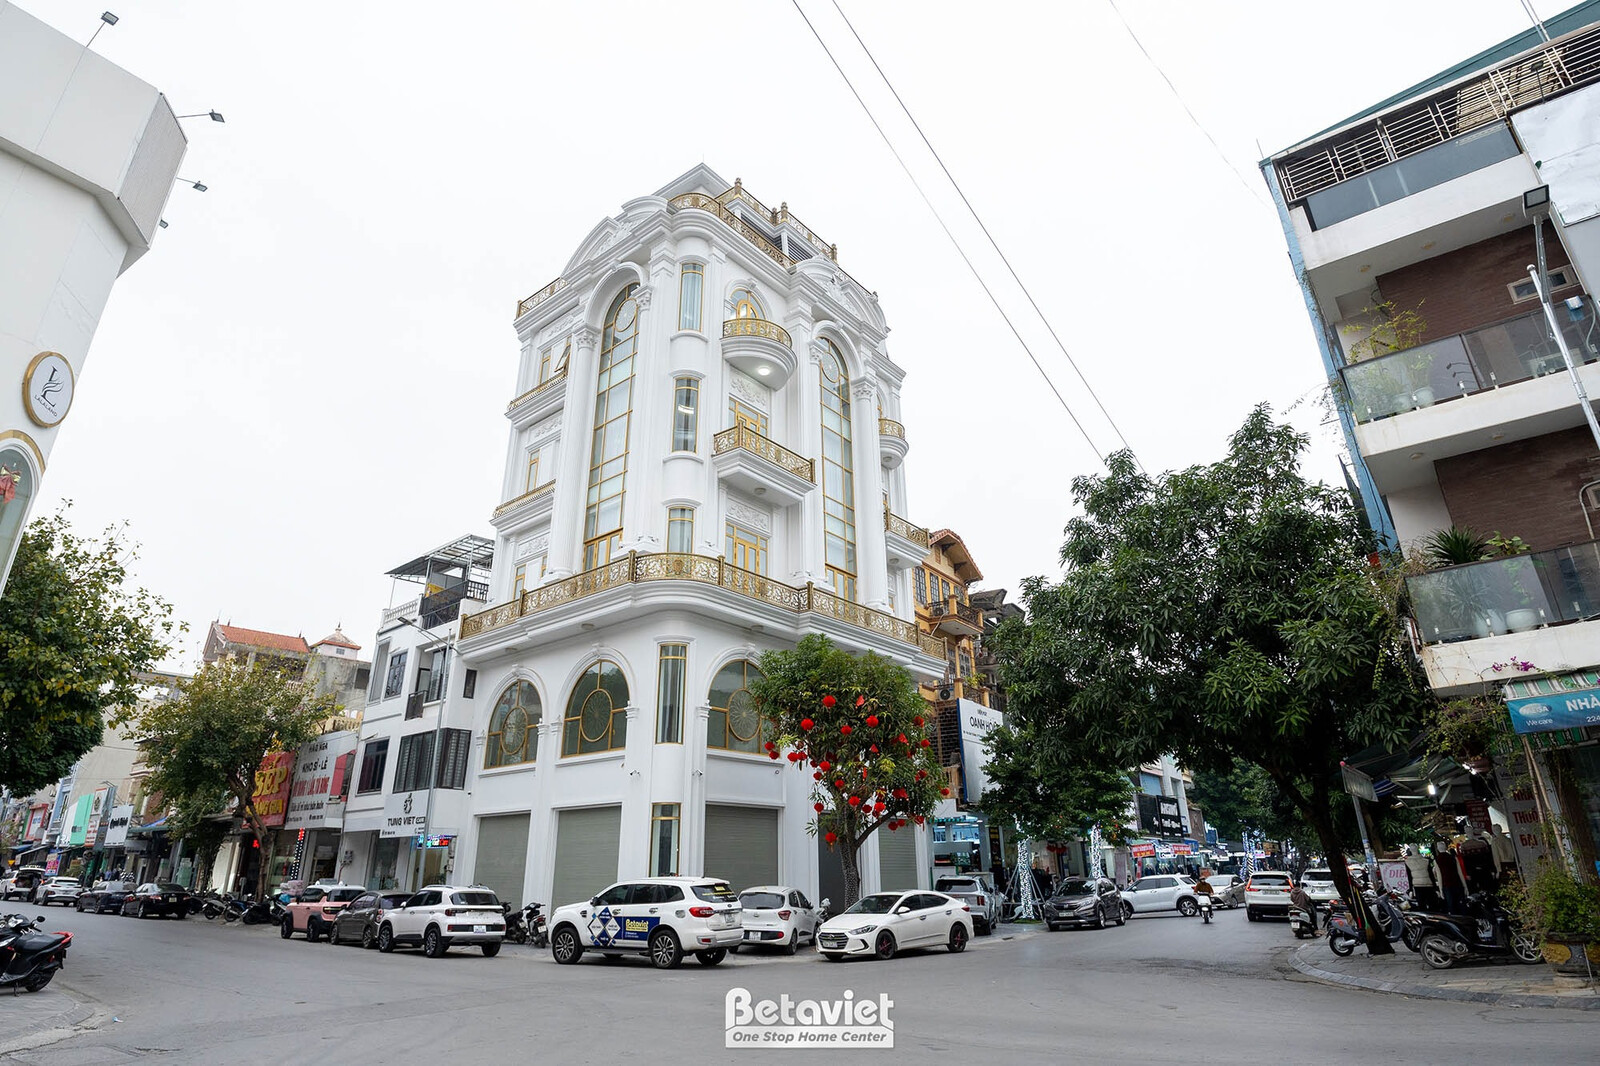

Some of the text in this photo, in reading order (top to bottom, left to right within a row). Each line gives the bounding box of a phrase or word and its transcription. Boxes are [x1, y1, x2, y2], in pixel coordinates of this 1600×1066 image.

[33, 394, 58, 417] LALALAND
[969, 715, 986, 731] OANH
[1526, 719, 1538, 727] We
